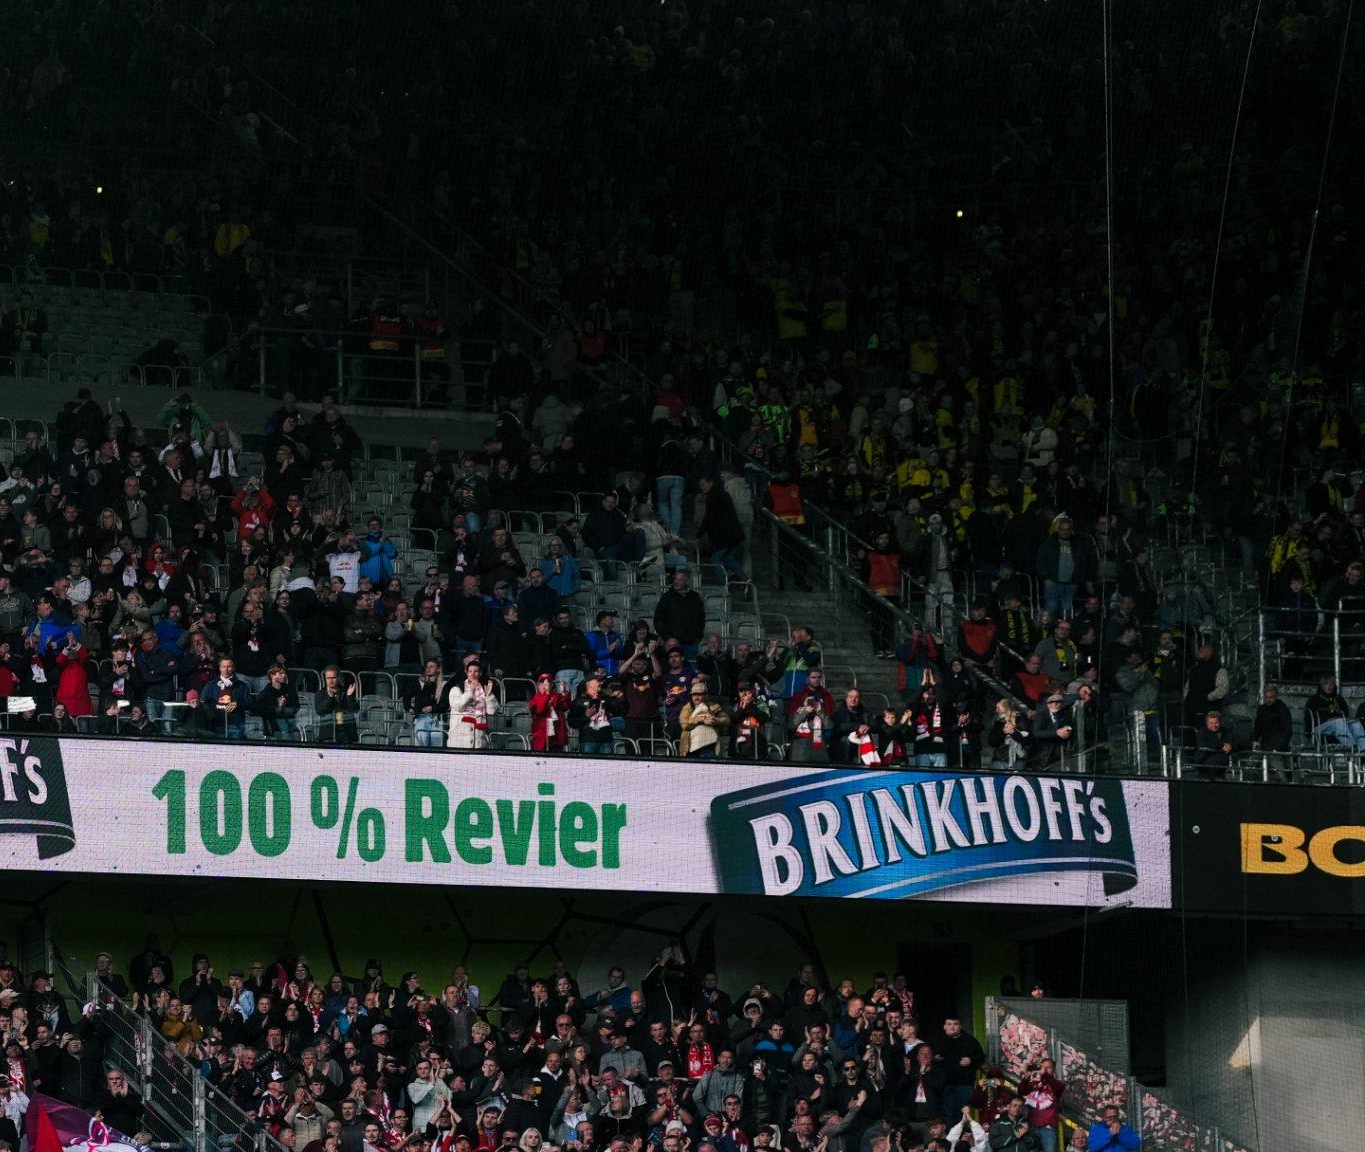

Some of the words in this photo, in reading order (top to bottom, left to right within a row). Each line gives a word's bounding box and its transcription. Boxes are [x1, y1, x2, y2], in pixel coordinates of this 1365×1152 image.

[152, 769, 292, 857] 100
[312, 775, 385, 862] %
[405, 778, 627, 869] Revier
